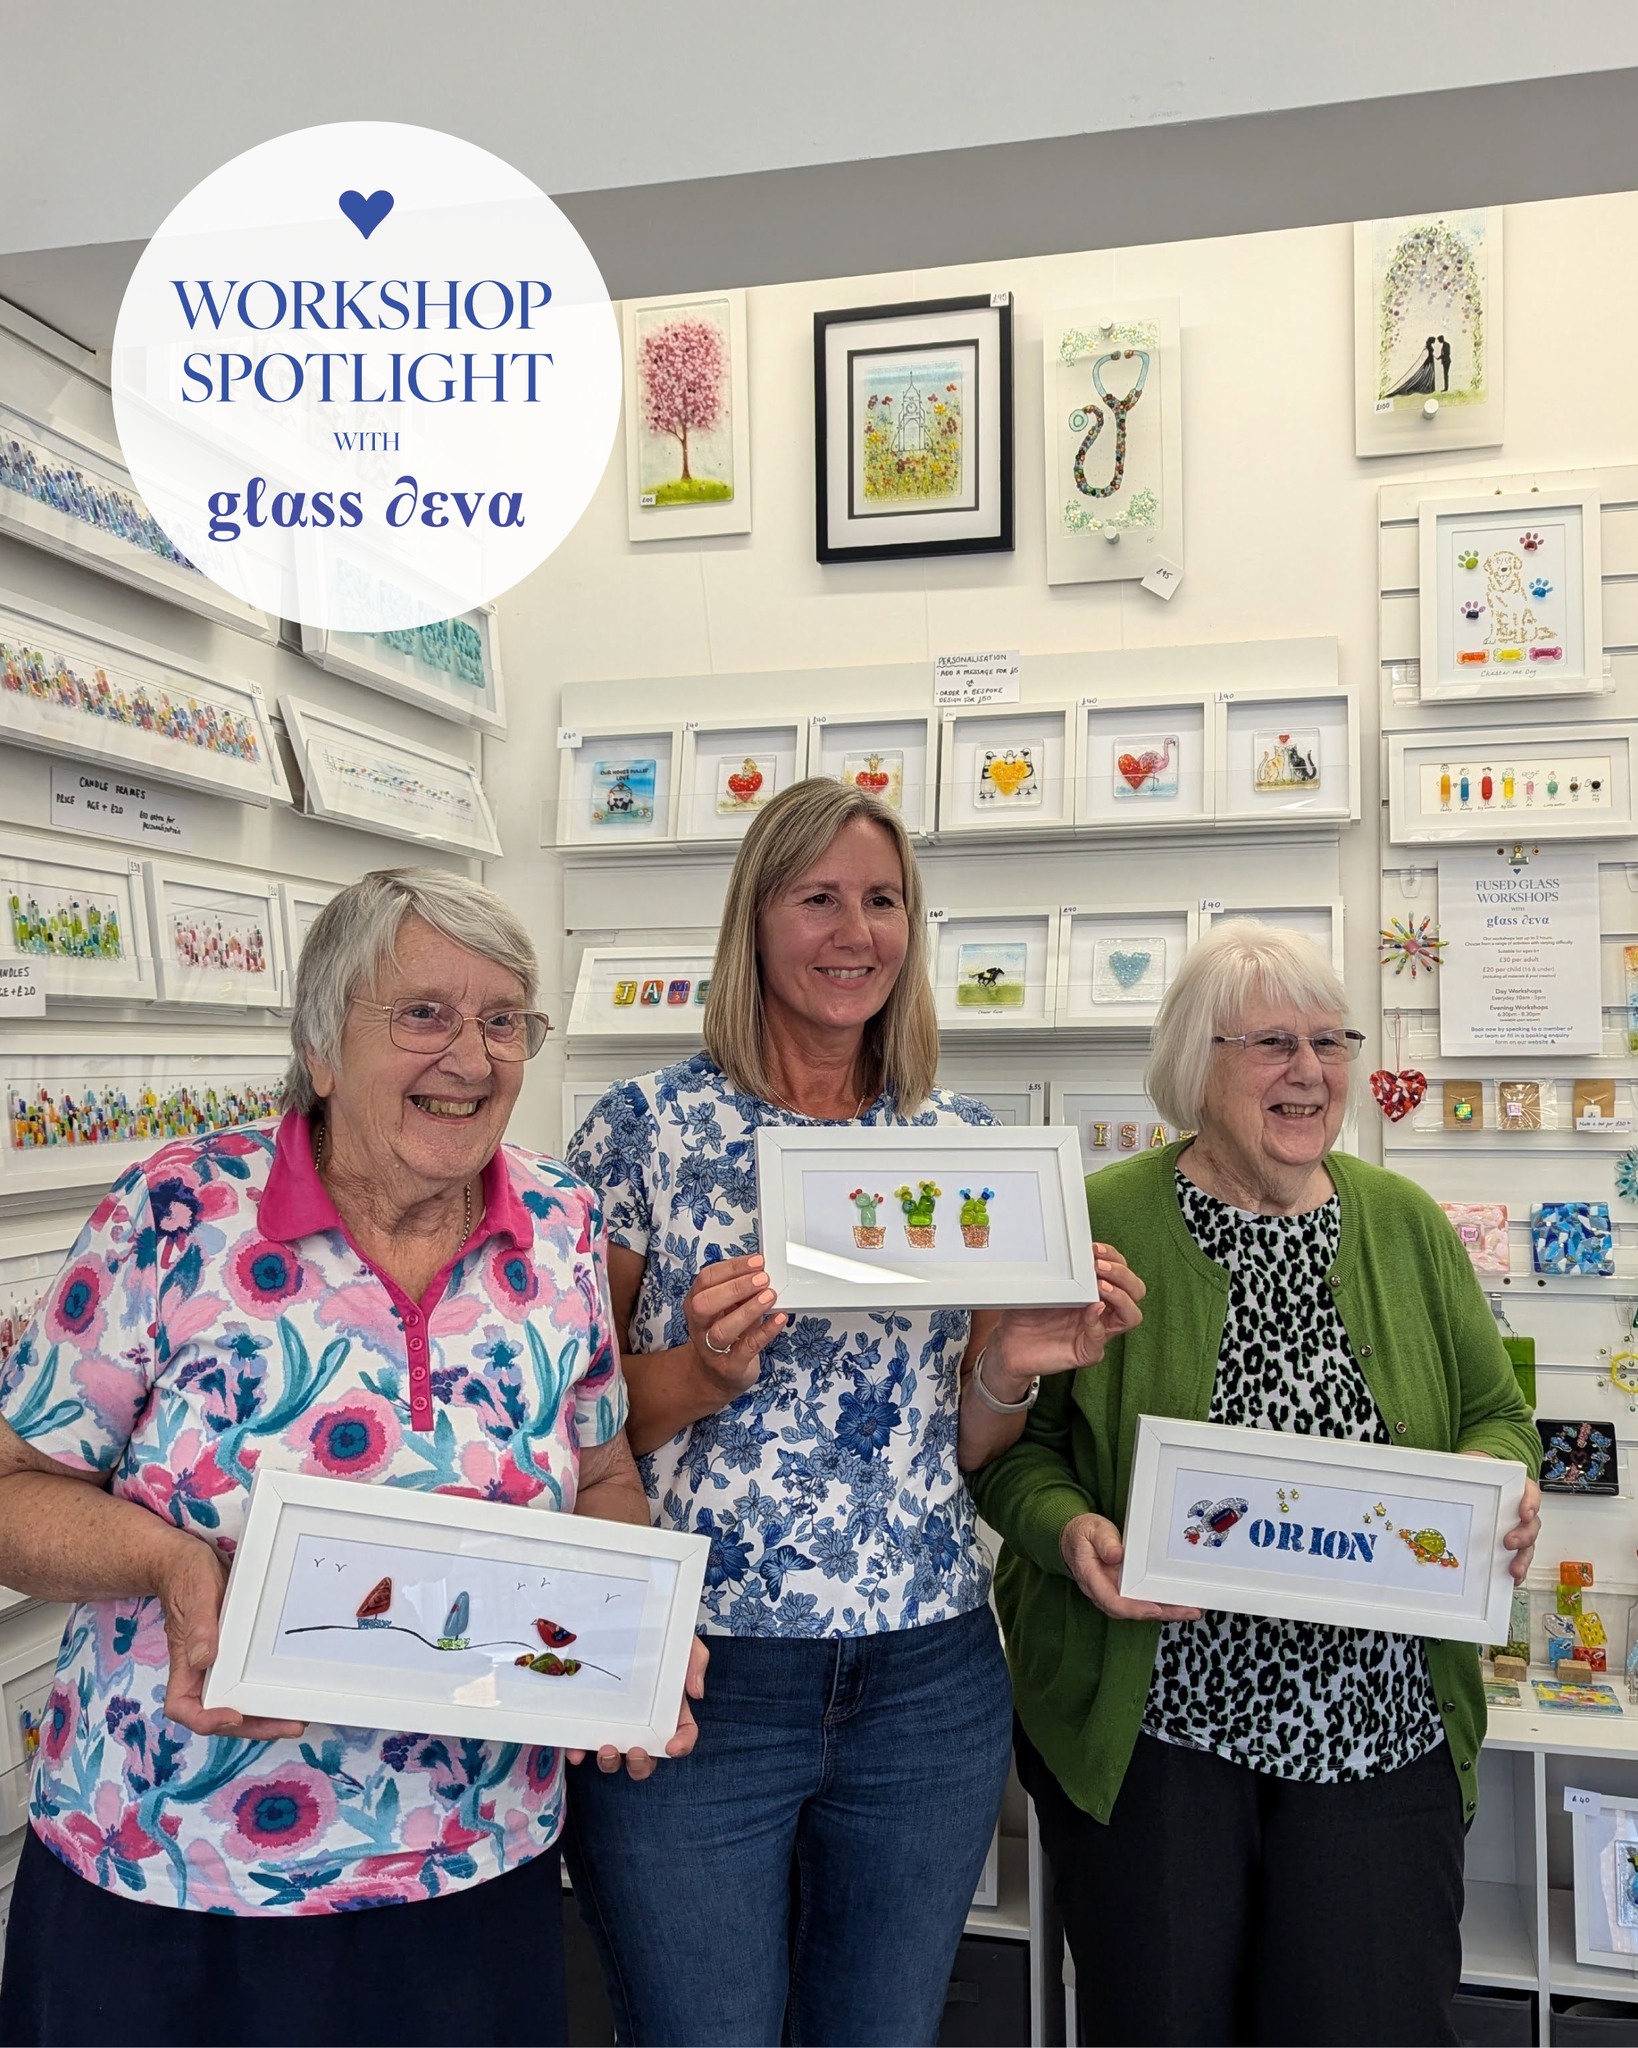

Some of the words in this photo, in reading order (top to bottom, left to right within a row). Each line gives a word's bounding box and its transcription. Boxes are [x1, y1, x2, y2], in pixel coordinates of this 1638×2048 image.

[992, 293, 1008, 304] £95
[1376, 403, 1390, 411] £100
[1155, 568, 1174, 580] £95
[938, 654, 1007, 666] PERSONALISATION
[972, 687, 1003, 695] BESPOKE
[812, 716, 826, 725] £40
[79, 776, 109, 792] CANDLE
[115, 785, 146, 800] FRAMES
[56, 793, 75, 805] PRICE
[87, 800, 100, 810] AGE
[110, 803, 123, 814] £20
[1476, 880, 1516, 890] FUSED
[1519, 879, 1560, 889] GLASS
[1477, 892, 1559, 903] WORKSHOPS
[1201, 900, 1221, 911] £40
[929, 910, 943, 918] £40
[1249, 1519, 1378, 1563] ORION
[1572, 1795, 1590, 1804] £40
